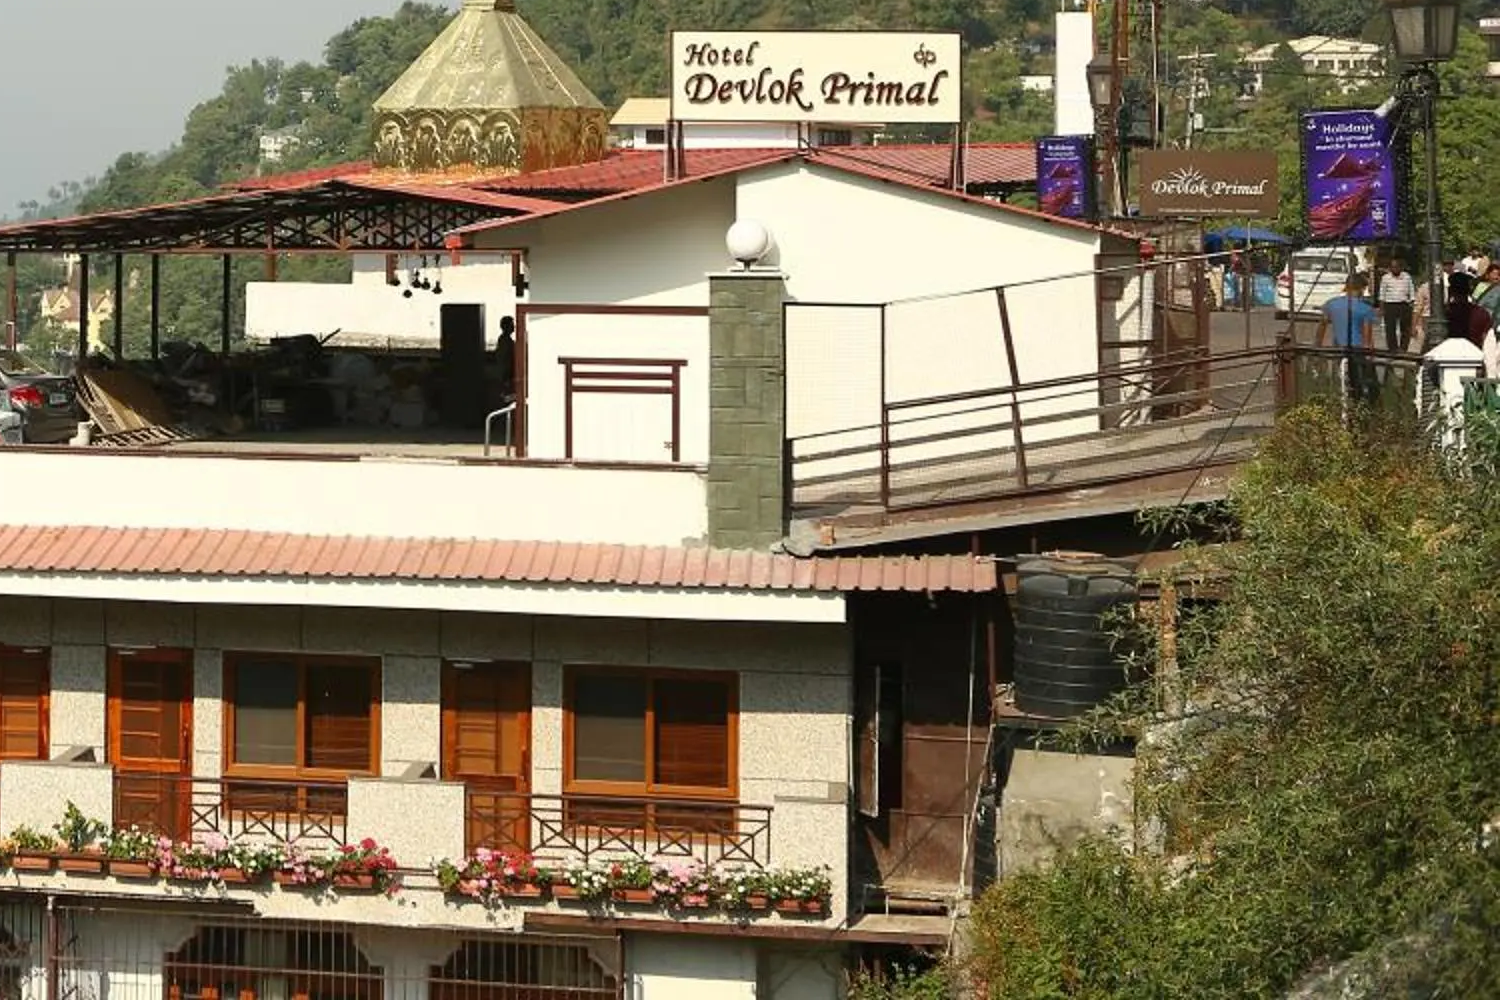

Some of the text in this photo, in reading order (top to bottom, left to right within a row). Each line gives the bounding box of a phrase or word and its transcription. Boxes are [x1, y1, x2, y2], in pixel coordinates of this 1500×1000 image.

[684, 41, 759, 66] Hotel
[685, 67, 948, 111] Devlok Primal
[1151, 179, 1268, 198] Devlok Primal
